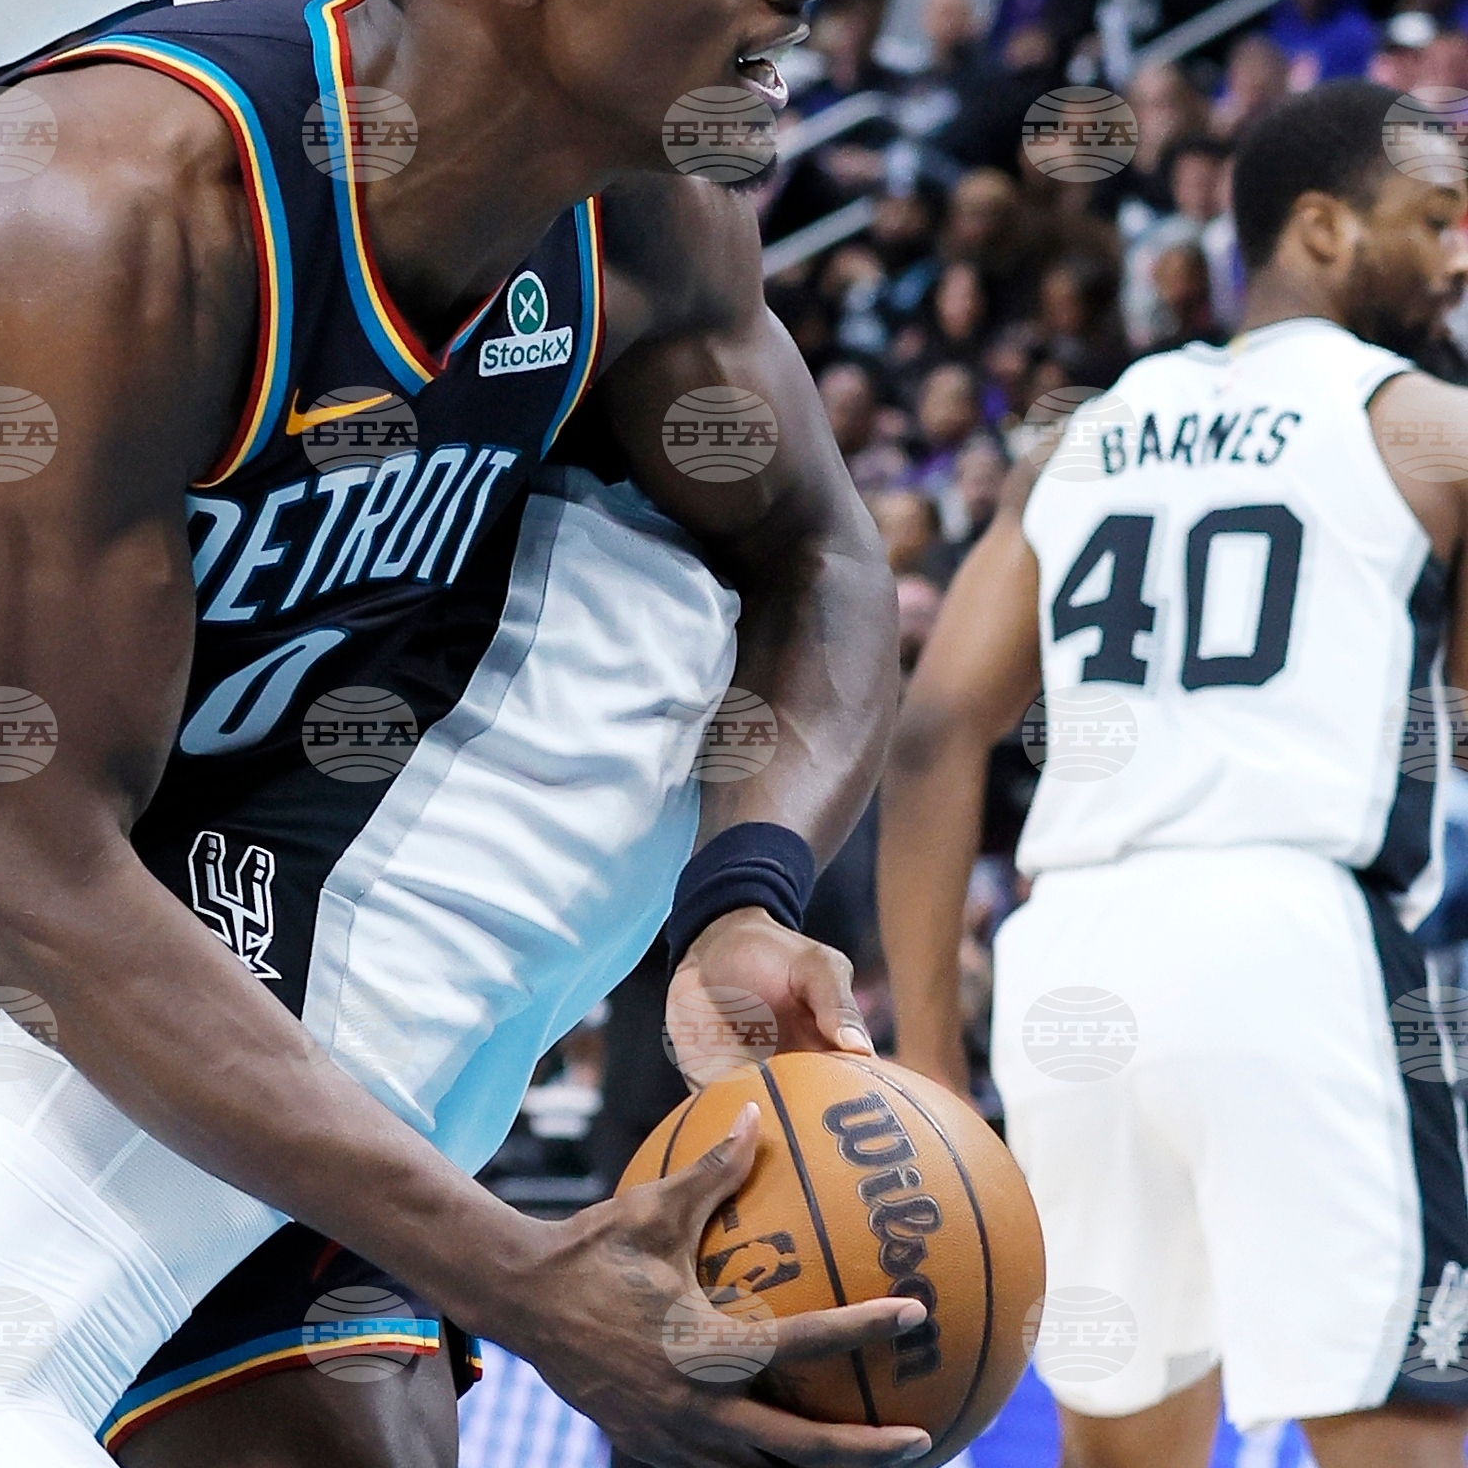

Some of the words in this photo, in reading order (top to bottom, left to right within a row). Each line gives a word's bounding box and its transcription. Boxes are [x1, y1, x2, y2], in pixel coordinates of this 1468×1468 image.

[483, 333, 570, 370] StockX
[1100, 405, 1302, 476] BARNES
[185, 443, 523, 624] DETROIT
[1051, 503, 1305, 693] 40
[178, 627, 352, 756] 0
